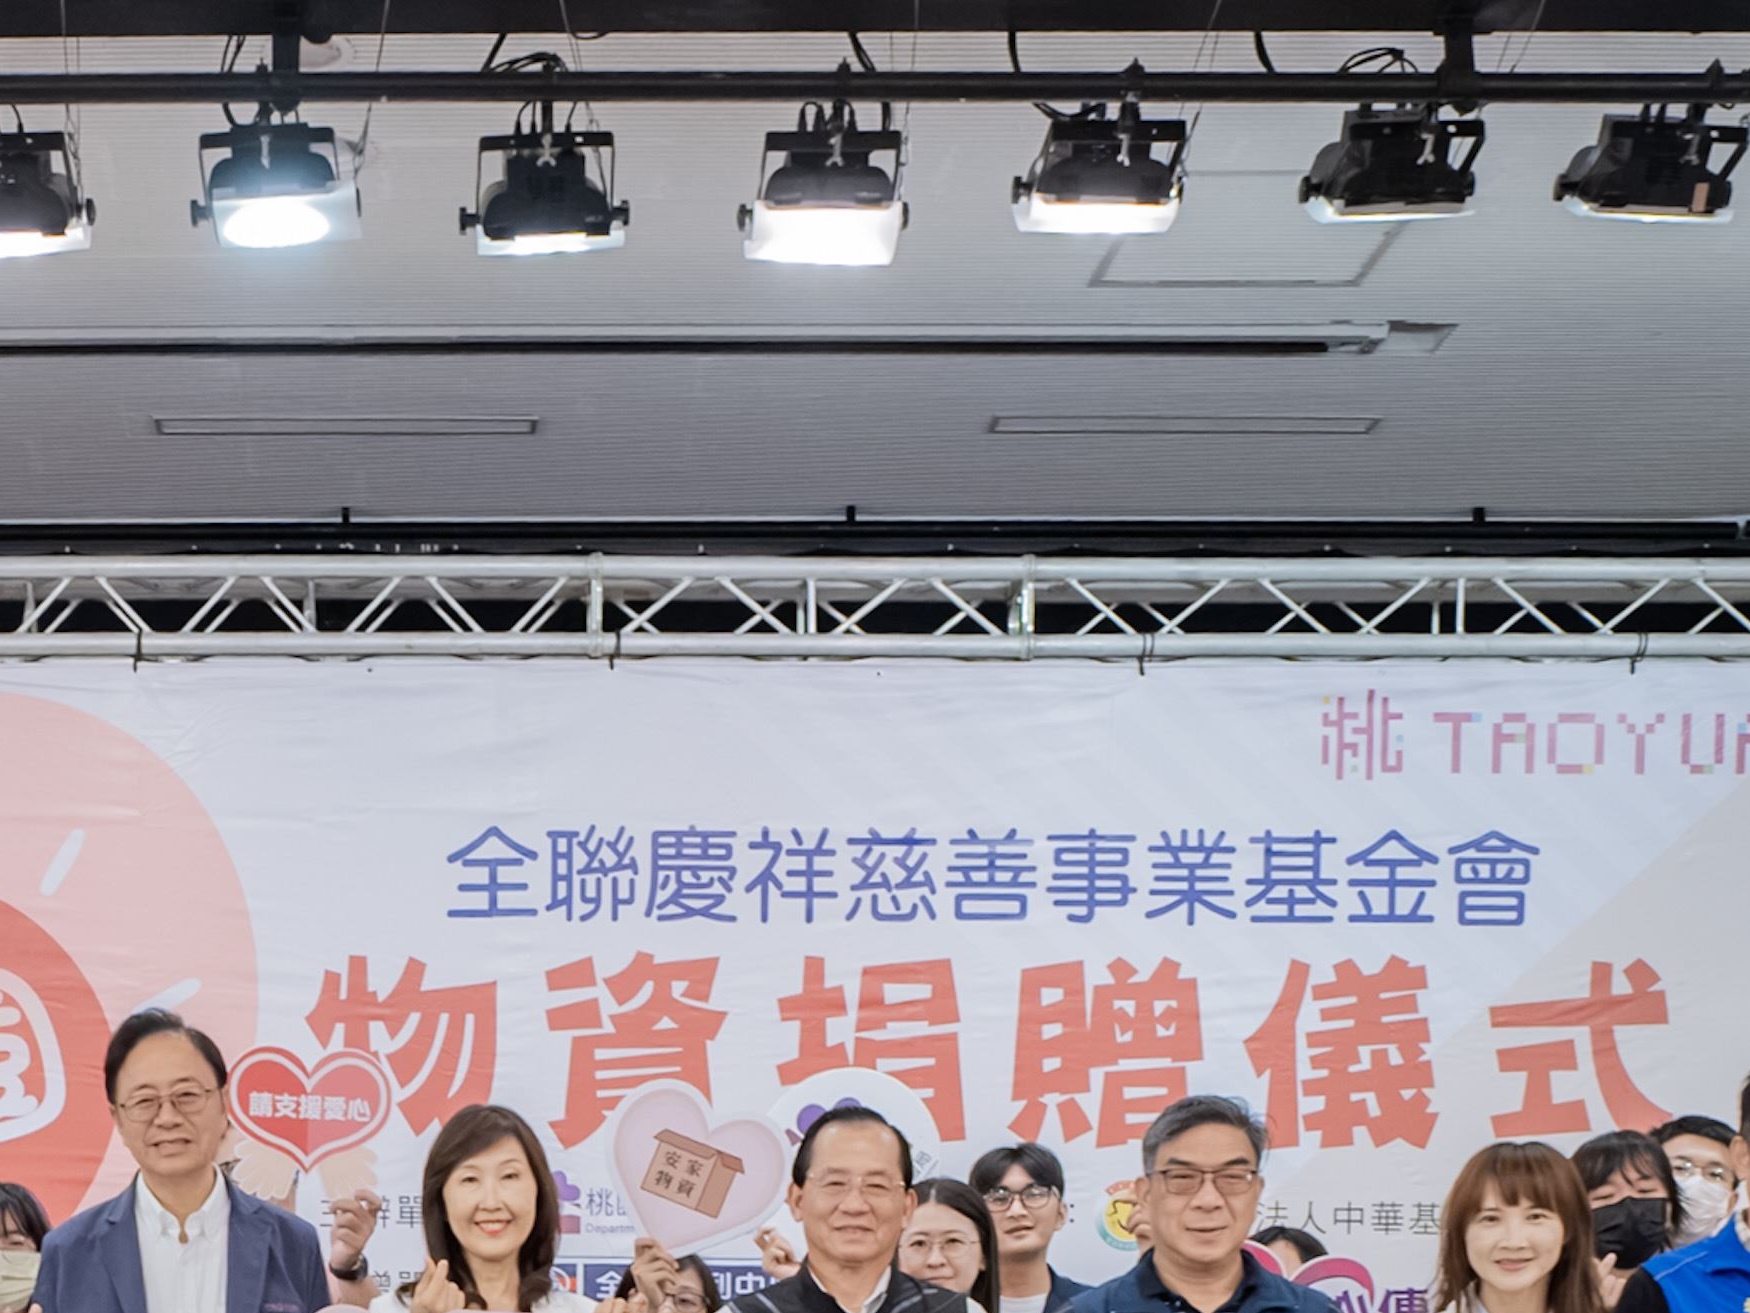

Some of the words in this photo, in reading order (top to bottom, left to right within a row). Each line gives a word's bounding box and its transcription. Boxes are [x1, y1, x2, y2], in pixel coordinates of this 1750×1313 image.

[445, 822, 1541, 928] 全聯慶祥慈善事業基金會
[308, 951, 1673, 1152] 物資捐贈儀式
[248, 1090, 372, 1123] 請支援愛心
